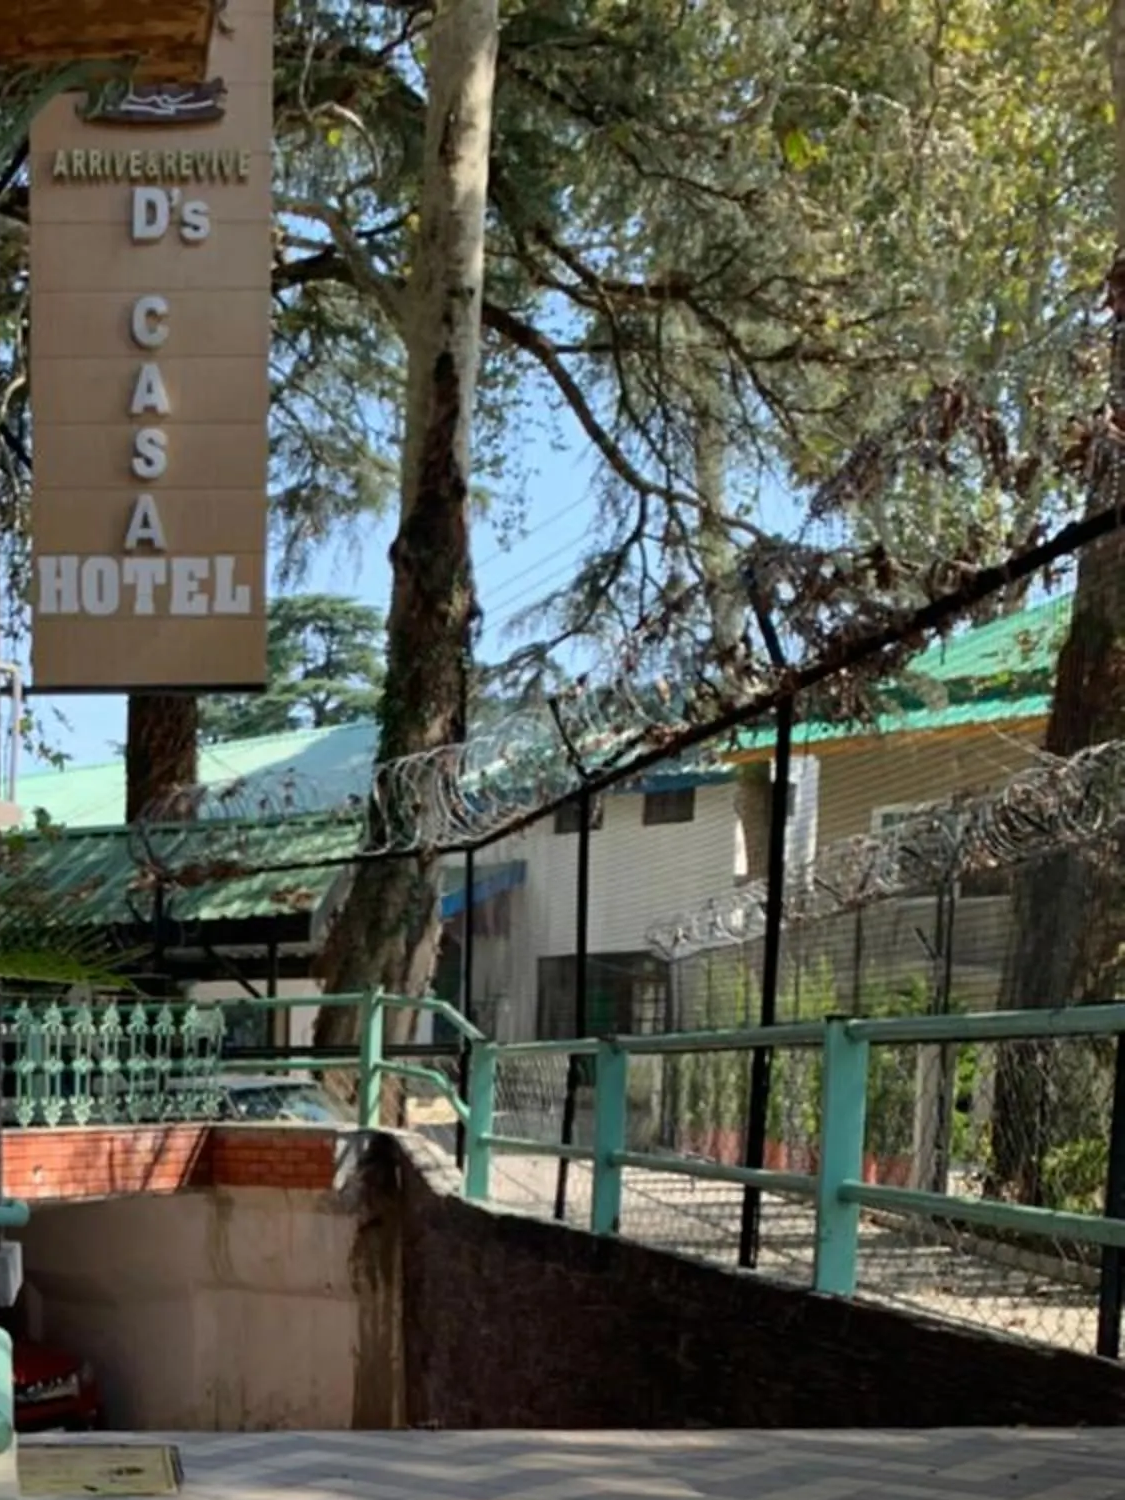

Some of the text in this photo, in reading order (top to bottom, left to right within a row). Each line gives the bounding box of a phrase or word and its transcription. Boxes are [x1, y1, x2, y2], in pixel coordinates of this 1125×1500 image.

[131, 186, 211, 243] D's
[124, 293, 171, 551] CASA
[37, 555, 252, 616] HOTEL
